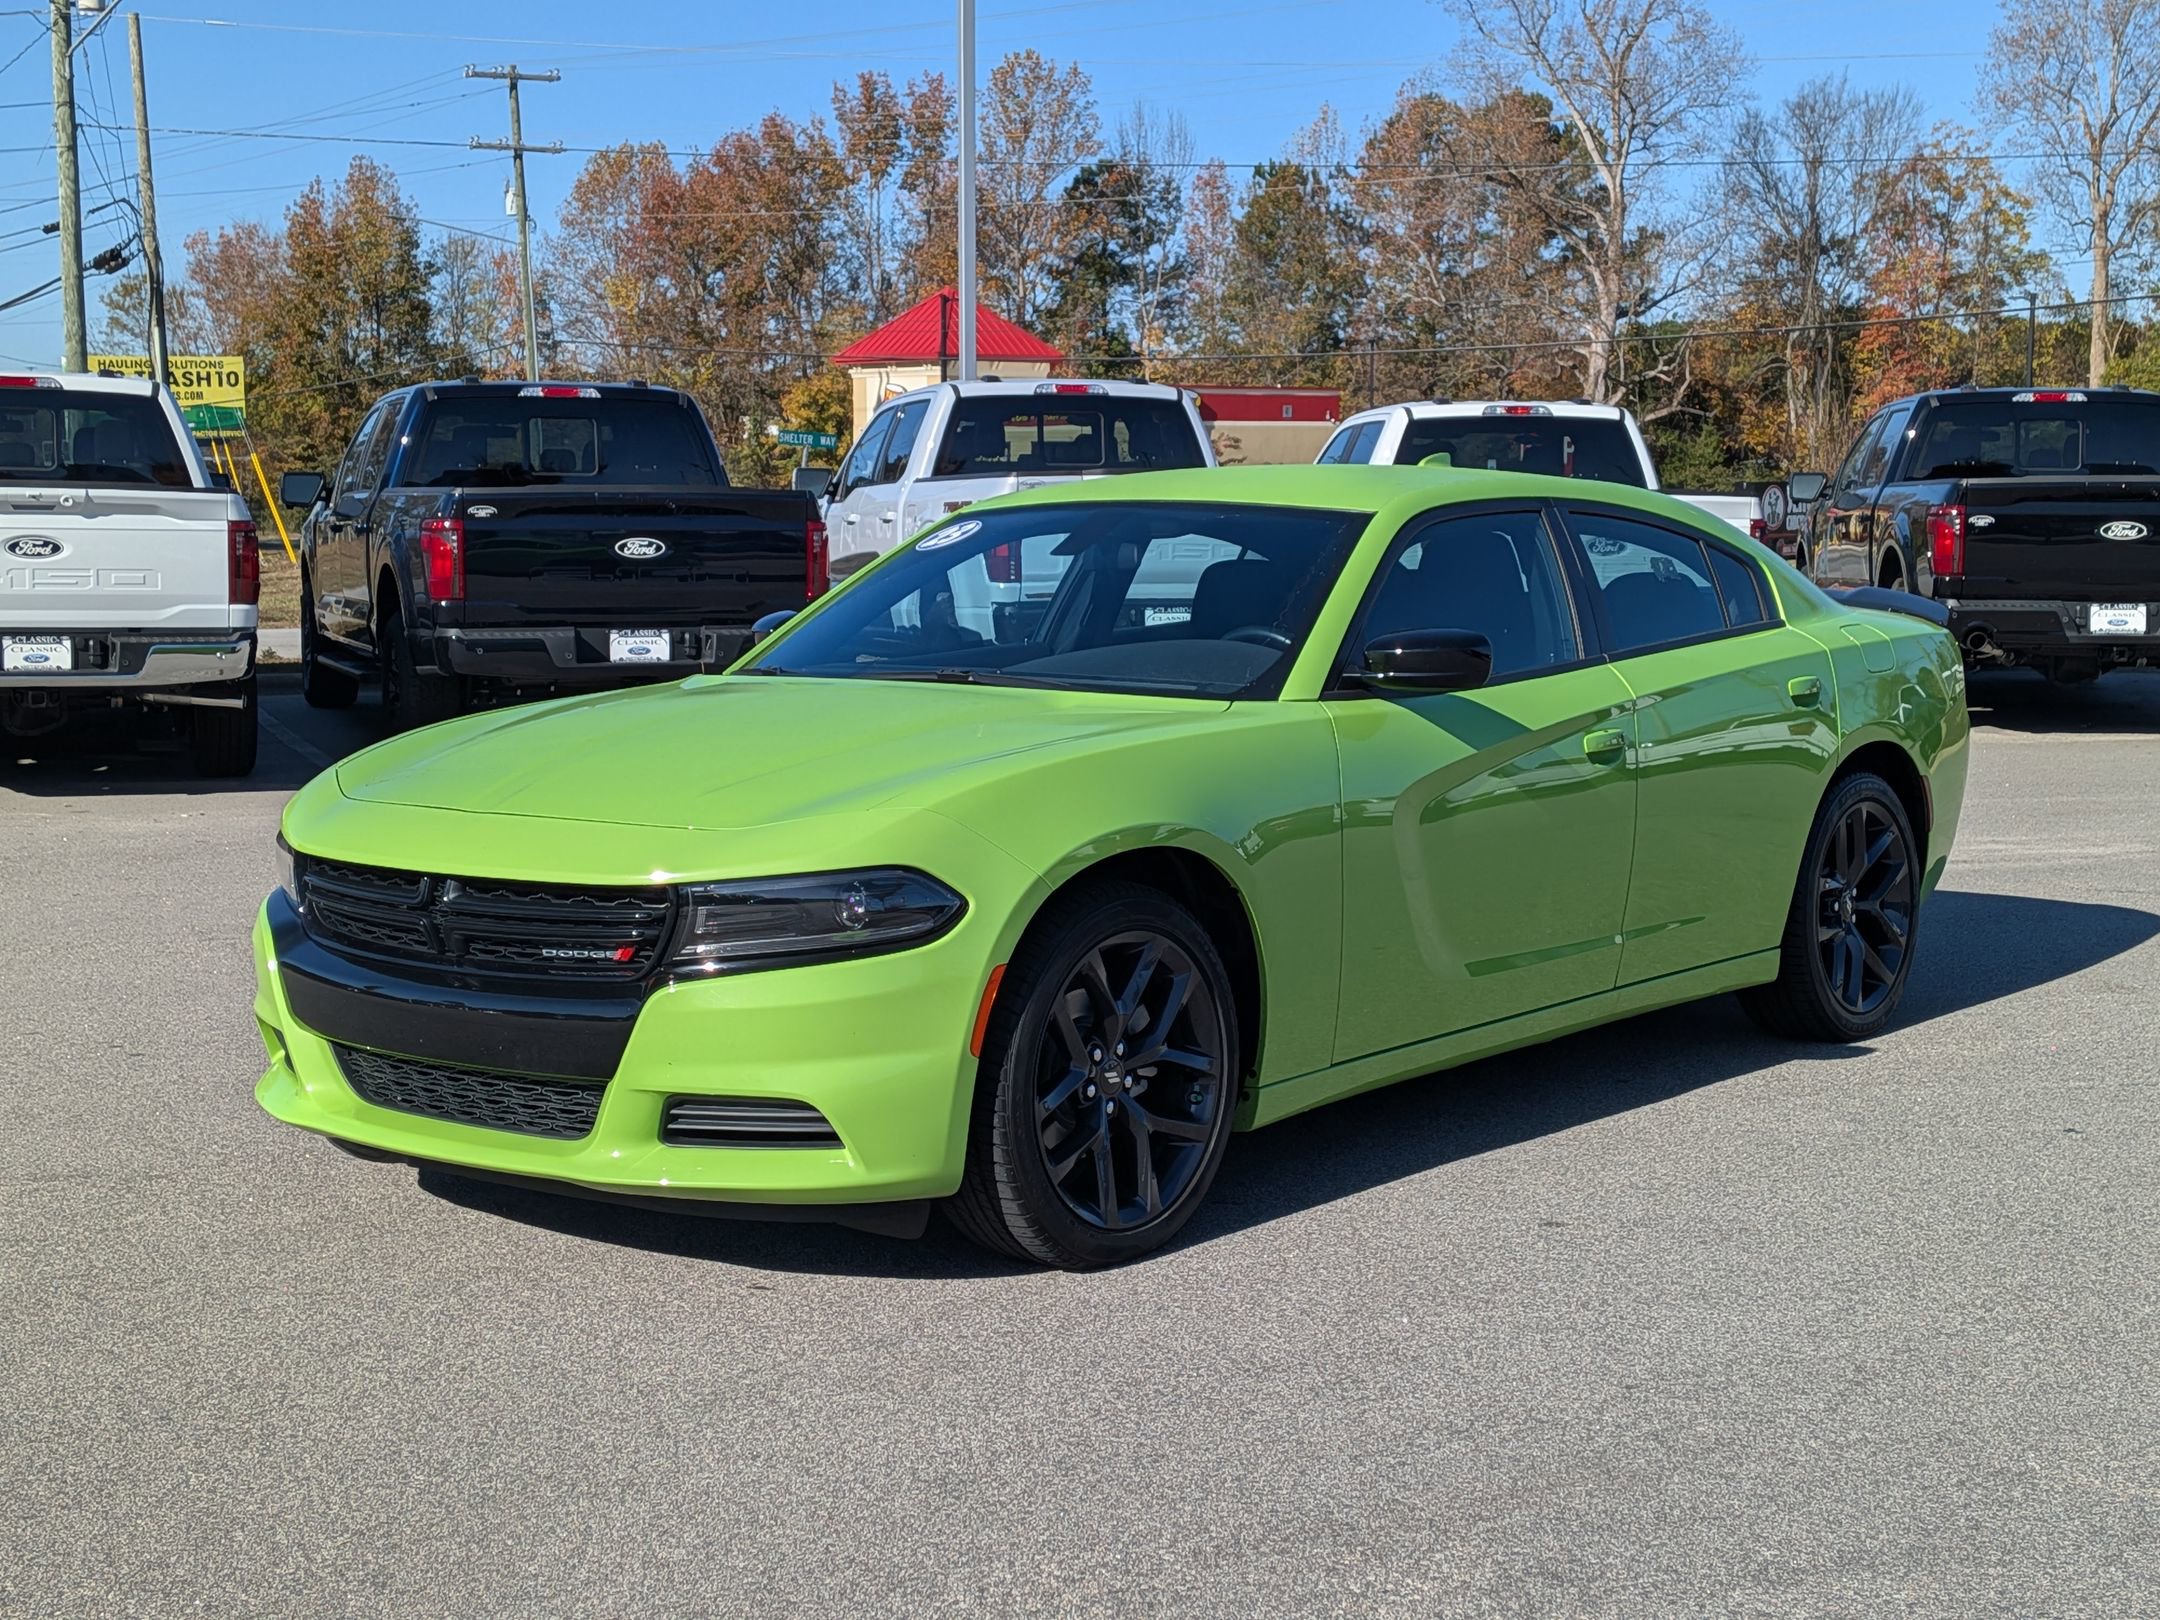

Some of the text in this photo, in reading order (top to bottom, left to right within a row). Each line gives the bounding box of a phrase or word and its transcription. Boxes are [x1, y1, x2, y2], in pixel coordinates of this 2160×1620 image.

[98, 359, 224, 369] HAULING OLUTIONS
[779, 432, 836, 446] SHELTER WAY
[2107, 523, 2139, 537] Ford
[15, 539, 53, 555] Ford
[624, 540, 656, 555] Ford
[1592, 537, 1620, 553] Ford
[15, 635, 59, 644] CLASSIC
[622, 629, 659, 637] CLASSIC
[542, 948, 618, 959] DODGE
